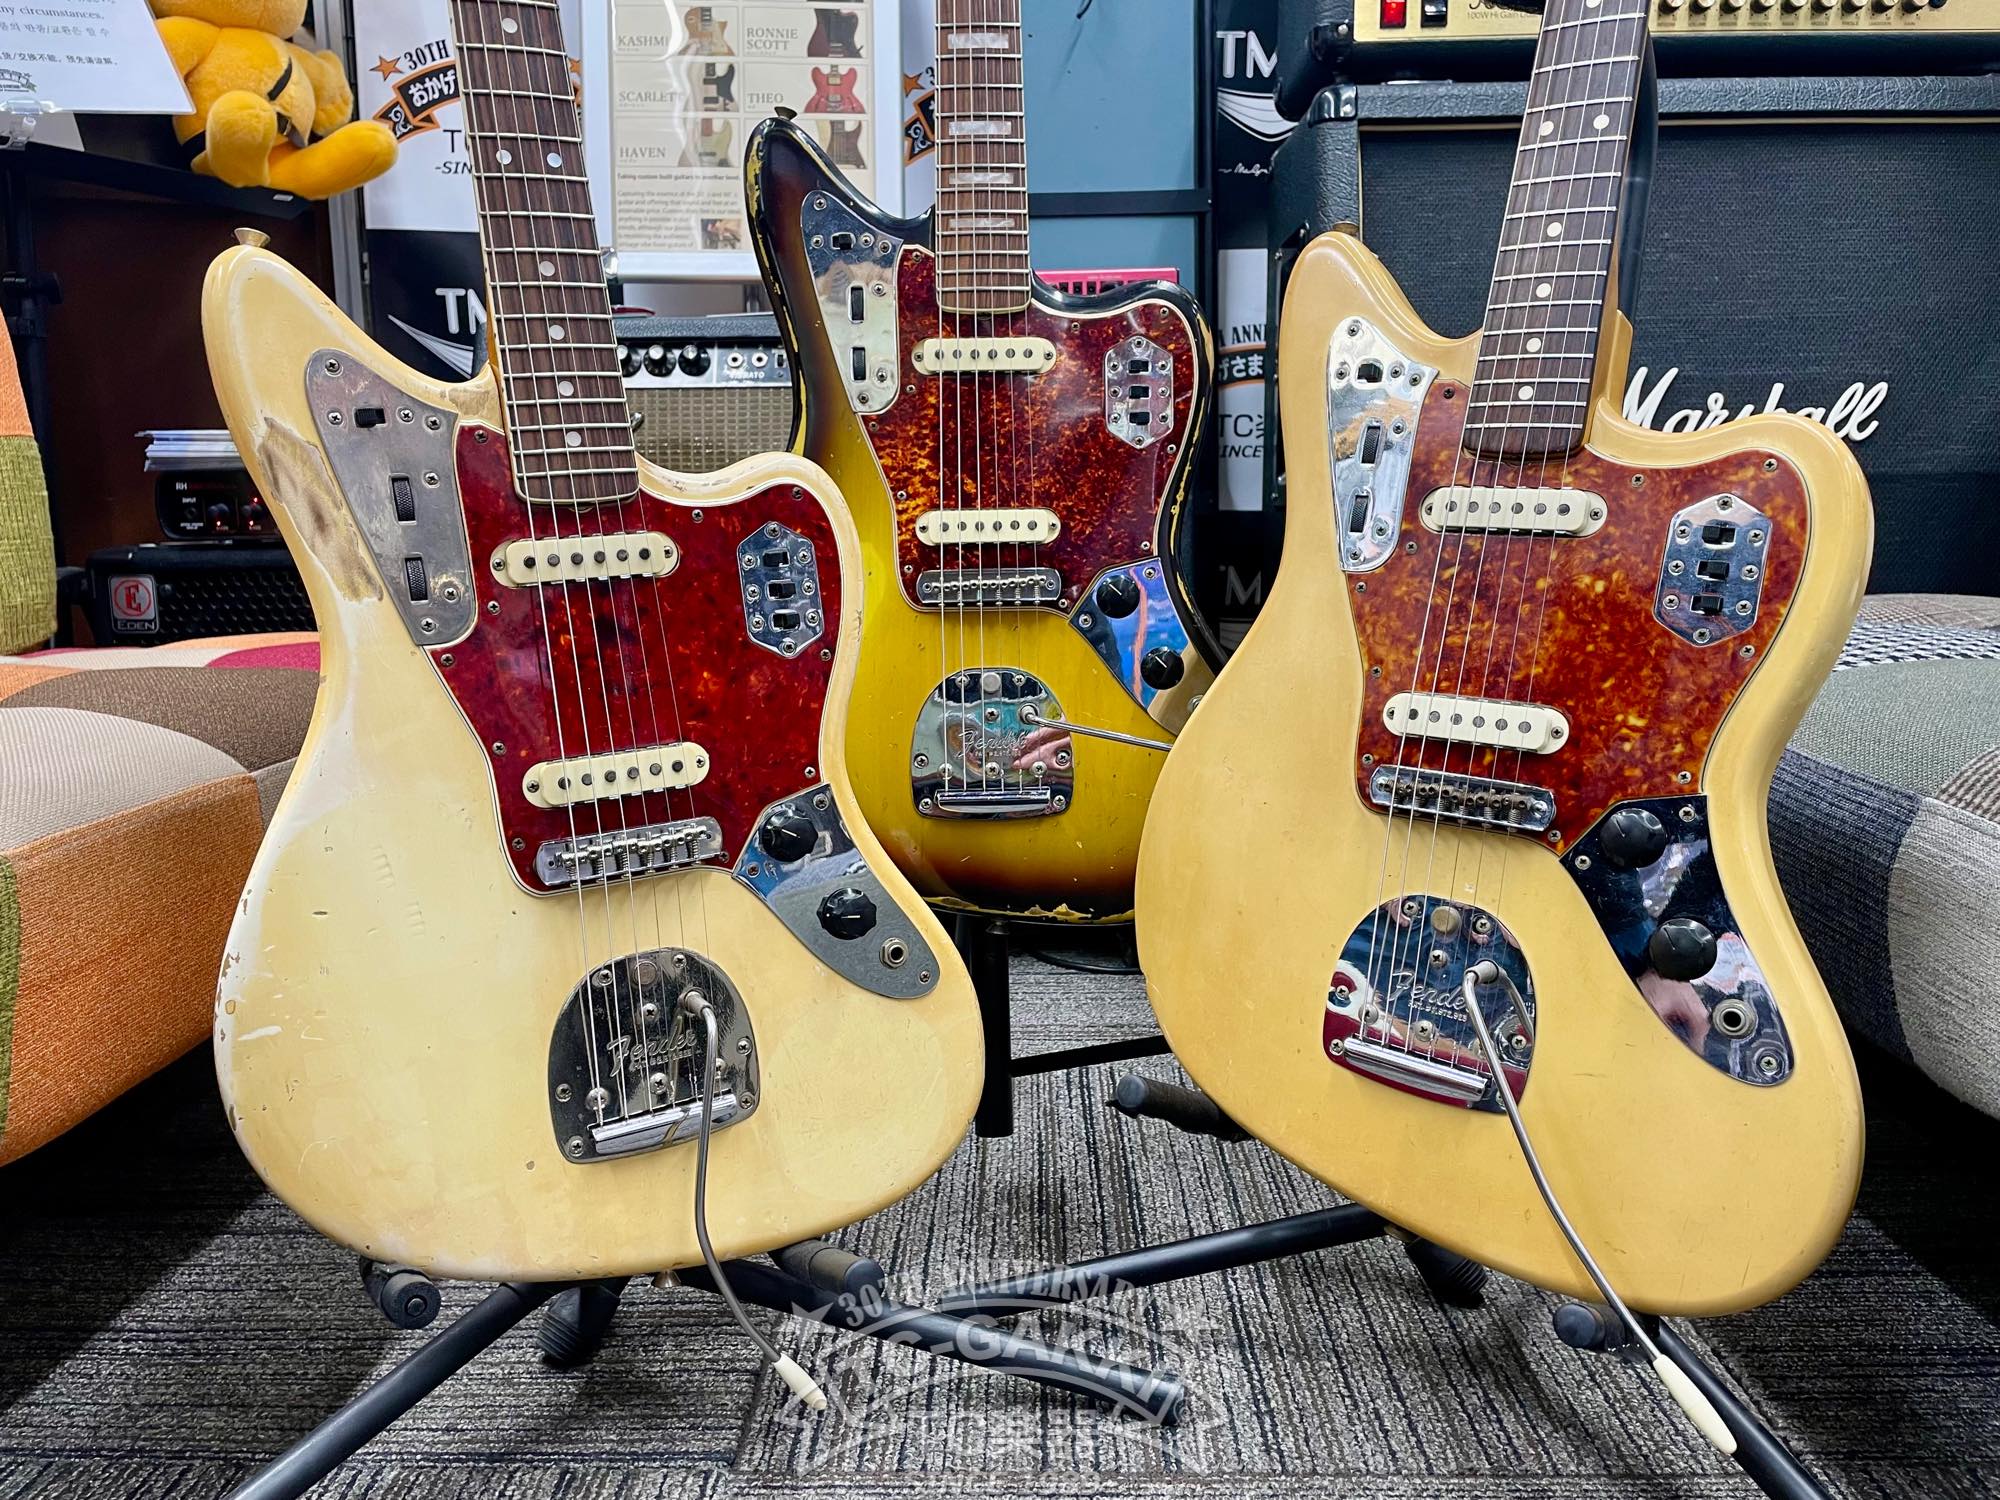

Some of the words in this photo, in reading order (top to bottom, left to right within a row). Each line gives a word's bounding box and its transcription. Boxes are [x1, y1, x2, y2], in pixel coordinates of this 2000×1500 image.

[0, 5, 14, 15] ny
[746, 28, 799, 39] RONNIE
[618, 35, 670, 47] KASHMI
[746, 40, 790, 51] SCOTT
[404, 39, 450, 70] 30TH
[746, 93, 784, 104] THEO
[619, 147, 666, 158] HAVEN
[954, 730, 1027, 759] Fender
[1387, 968, 1470, 1013] Fende
[606, 1025, 698, 1078] Fender
